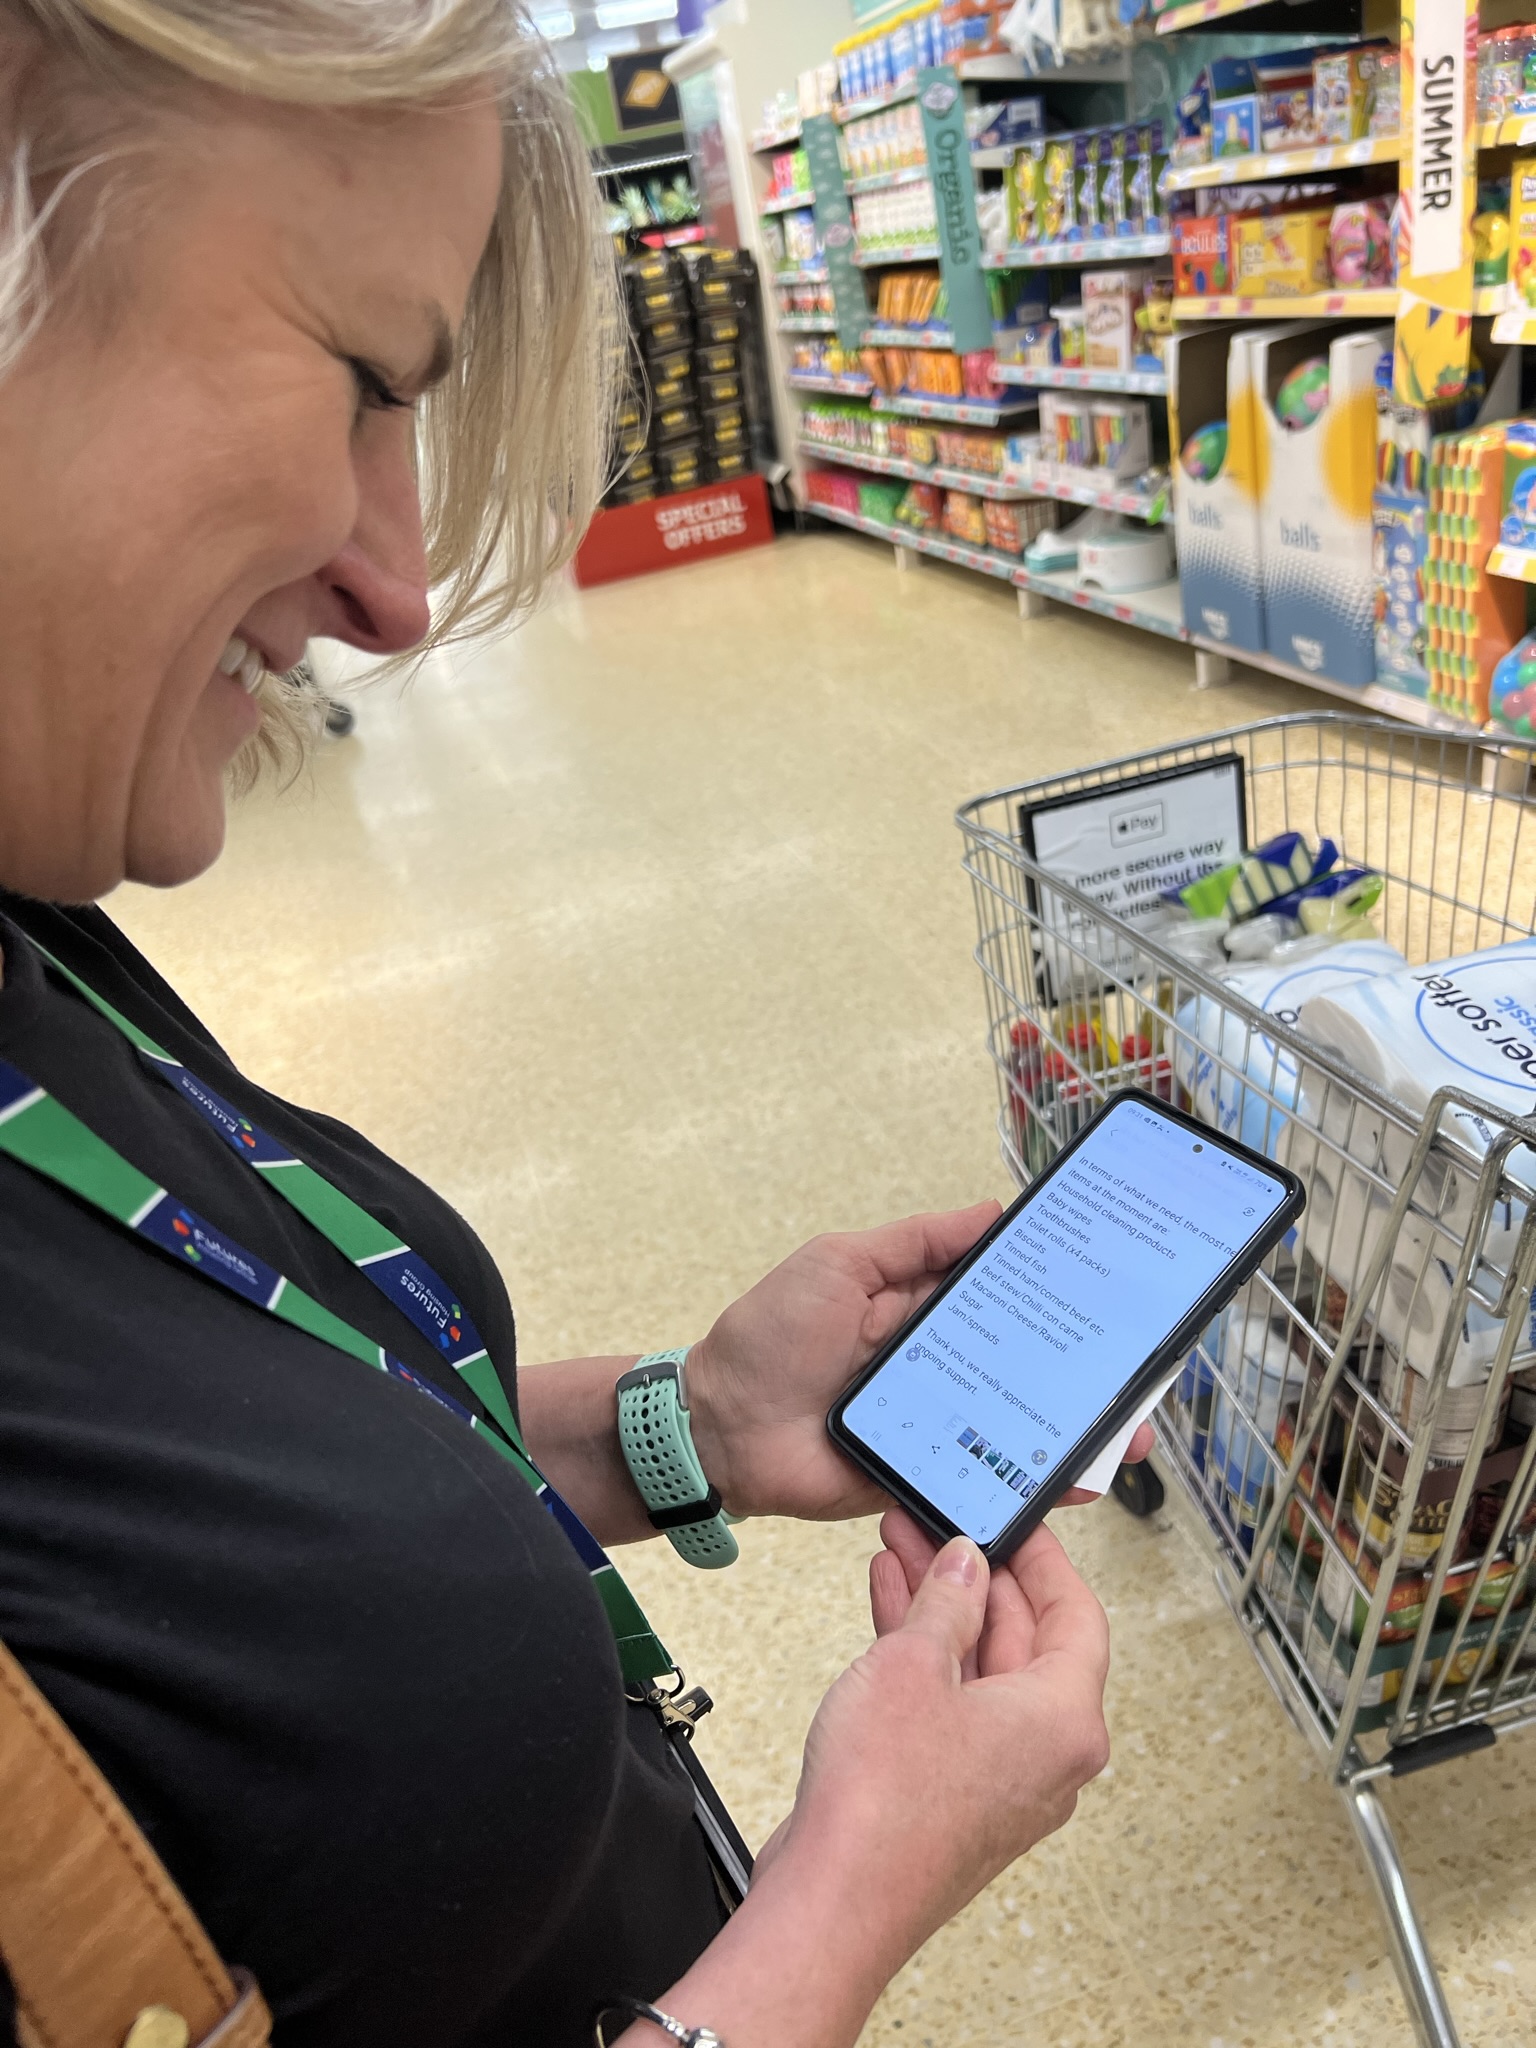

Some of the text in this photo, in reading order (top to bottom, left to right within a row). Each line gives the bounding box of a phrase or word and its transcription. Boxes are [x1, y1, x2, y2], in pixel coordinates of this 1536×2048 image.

[1422, 54, 1455, 212] SUMMER
[655, 490, 748, 532] SPECIAL
[663, 513, 748, 550] OFFERS
[1280, 517, 1321, 552] balls
[1075, 837, 1225, 889] more secure way
[1122, 868, 1193, 897] Without
[1411, 974, 1502, 1032] softer
[1046, 1192, 1093, 1226] Baby wipes
[1057, 1180, 1177, 1260] Household cleaning products
[1068, 1168, 1092, 1187] items
[1091, 1183, 1102, 1192] at
[1102, 1188, 1116, 1202] the
[1116, 1199, 1153, 1225] moment
[1079, 1157, 1089, 1166] In
[1089, 1162, 1113, 1181] terms
[1113, 1178, 1126, 1188] of
[1123, 1184, 1145, 1201] what
[1145, 1197, 1159, 1210] we
[1159, 1206, 1184, 1226] need,
[1184, 1220, 1199, 1234] the
[1199, 1230, 1226, 1250] most
[1014, 1228, 1047, 1254] Biscuits
[1026, 1216, 1111, 1278] Toilet rolls (x4 packs)
[1037, 1204, 1092, 1244] Toothbrushes
[194, 1228, 256, 1277] Futures
[1004, 1240, 1047, 1275] Tinned fish
[400, 1275, 448, 1329] Futures
[404, 1268, 450, 1318] Housing Group
[959, 1290, 983, 1311] Sugar
[970, 1278, 1069, 1353] Macaroni Cheese/Ravioli
[980, 1265, 1084, 1344] Beef stew/Chilli con carne
[992, 1252, 1105, 1336] Tinned ham/corned beef etc
[948, 1304, 1000, 1346] Jam/spreads
[914, 1342, 978, 1395] ongoing support.
[926, 1328, 1062, 1439] Thank you, we really appreciate the
